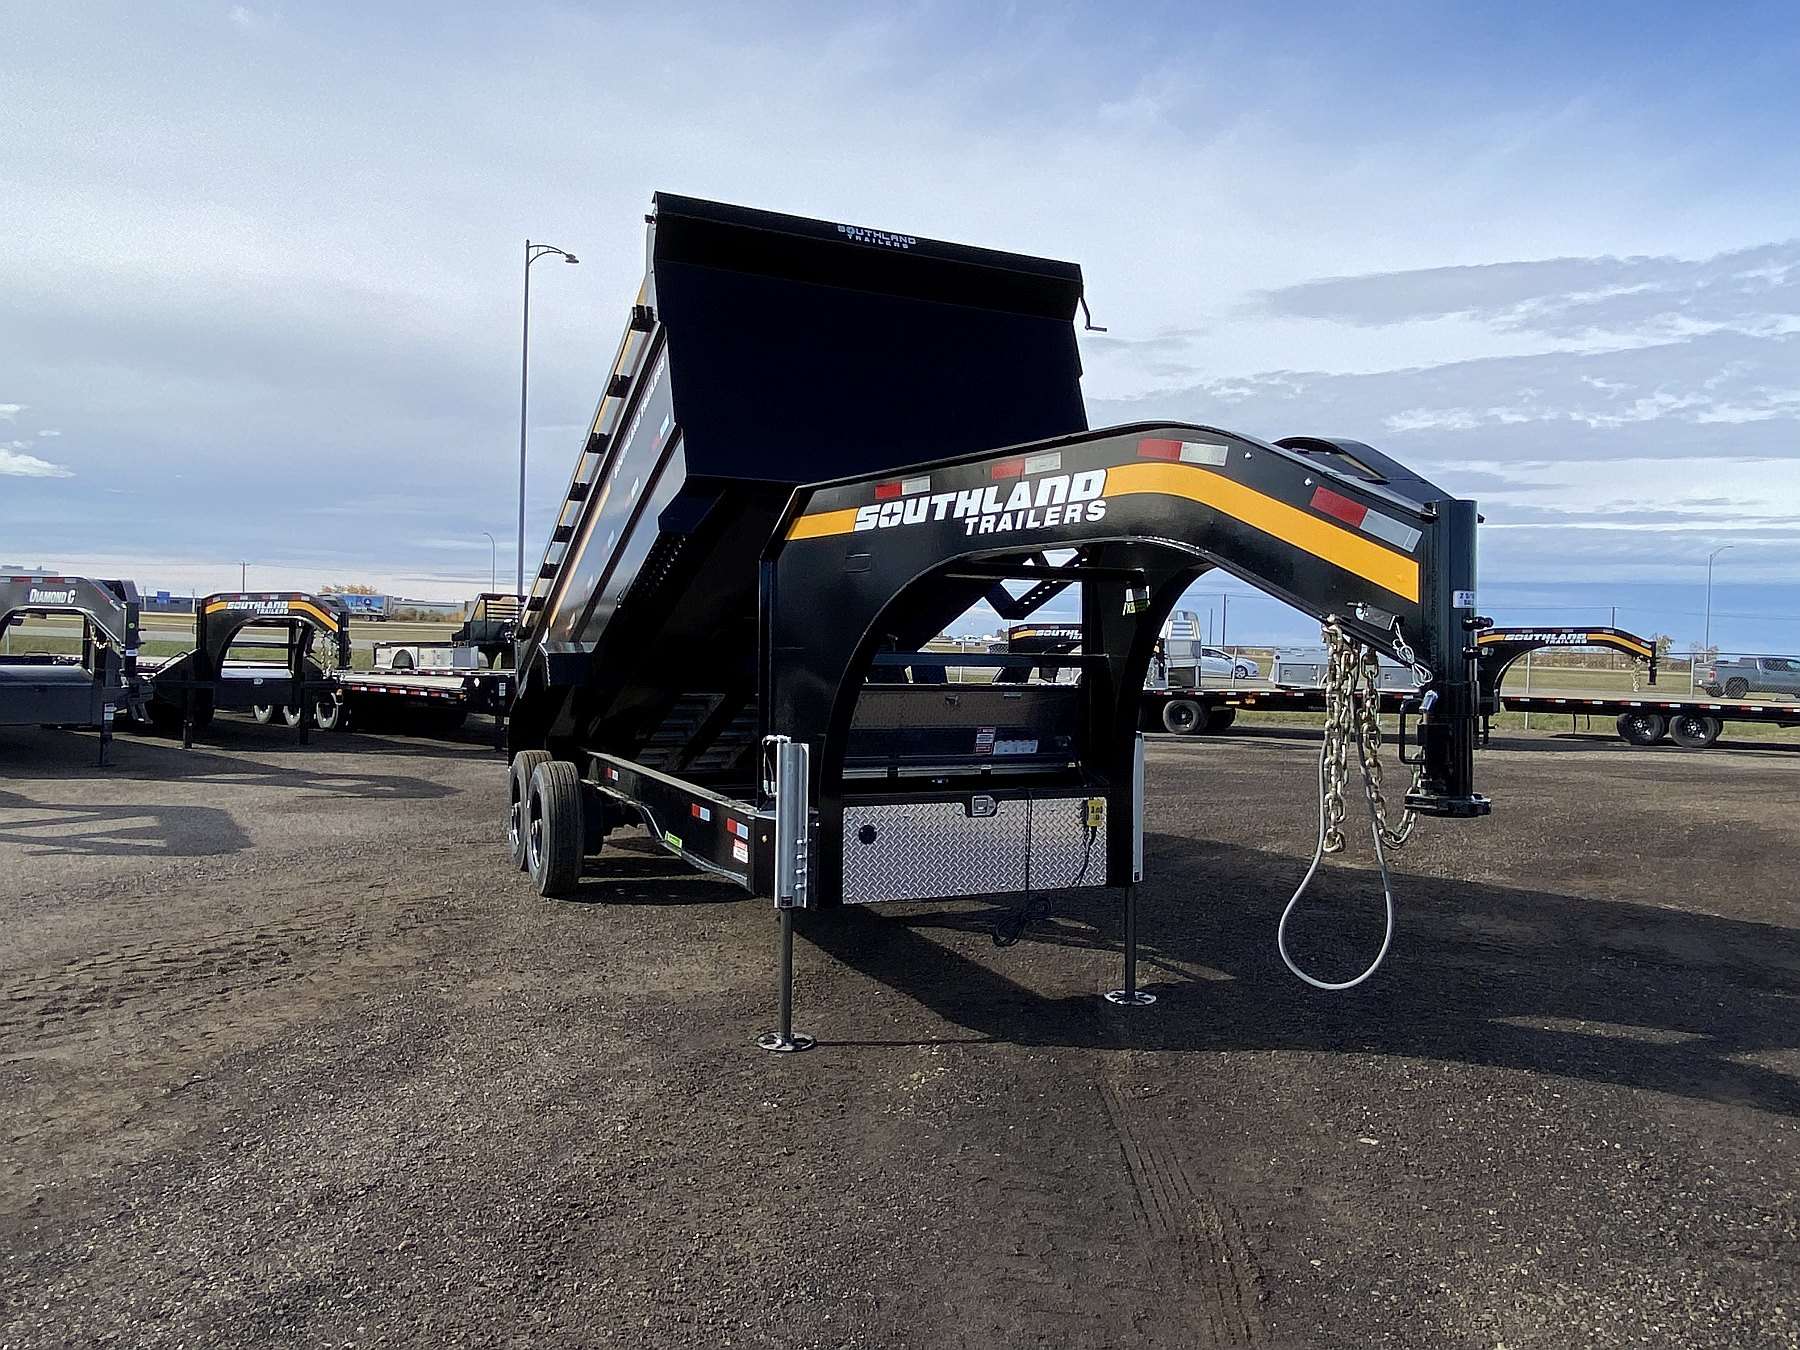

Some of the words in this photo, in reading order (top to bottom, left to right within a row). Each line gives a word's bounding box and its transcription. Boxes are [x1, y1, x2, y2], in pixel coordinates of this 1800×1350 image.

[837, 225, 917, 245] SOUTHLAND
[847, 233, 909, 249] TRAILERS
[854, 468, 1107, 532] SOUTHLAND
[965, 500, 1107, 536] TRAILERS
[29, 589, 68, 604] DIAMOND
[67, 589, 76, 604] C
[226, 601, 289, 610] SOUTHLAND
[1035, 629, 1083, 637] SOUTHL
[1504, 633, 1587, 641] SOUTHLAND
